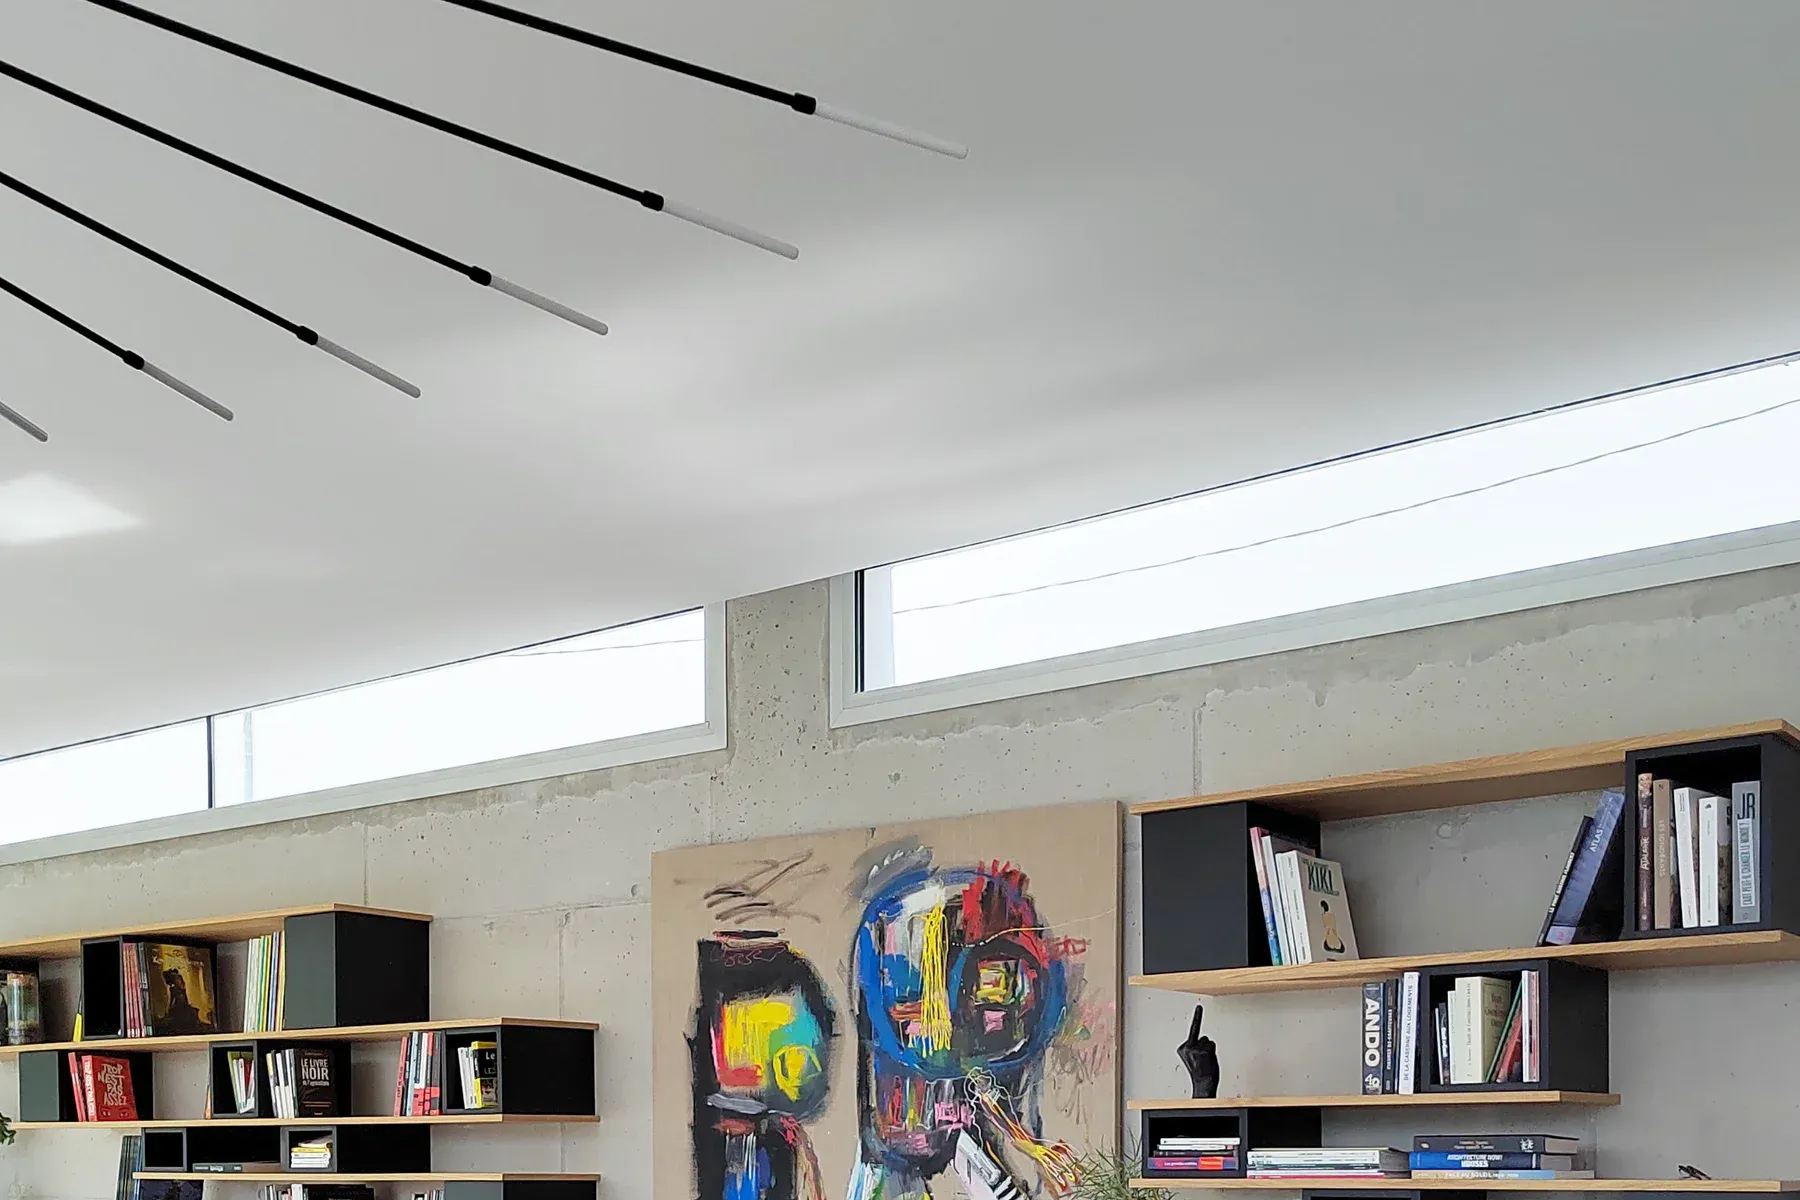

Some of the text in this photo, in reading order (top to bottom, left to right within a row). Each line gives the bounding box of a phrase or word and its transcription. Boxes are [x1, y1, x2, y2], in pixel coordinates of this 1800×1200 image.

[1737, 792, 1755, 820] JR
[1589, 828, 1604, 853] ATLAS
[1307, 861, 1334, 892] KIKI
[1364, 998, 1381, 1067] ANDO
[101, 1063, 123, 1074] TROP
[301, 1058, 328, 1068] LE LIVRE
[302, 1067, 329, 1080] NOIR
[106, 1083, 123, 1096] PAS
[104, 1091, 127, 1106] ASSEZ
